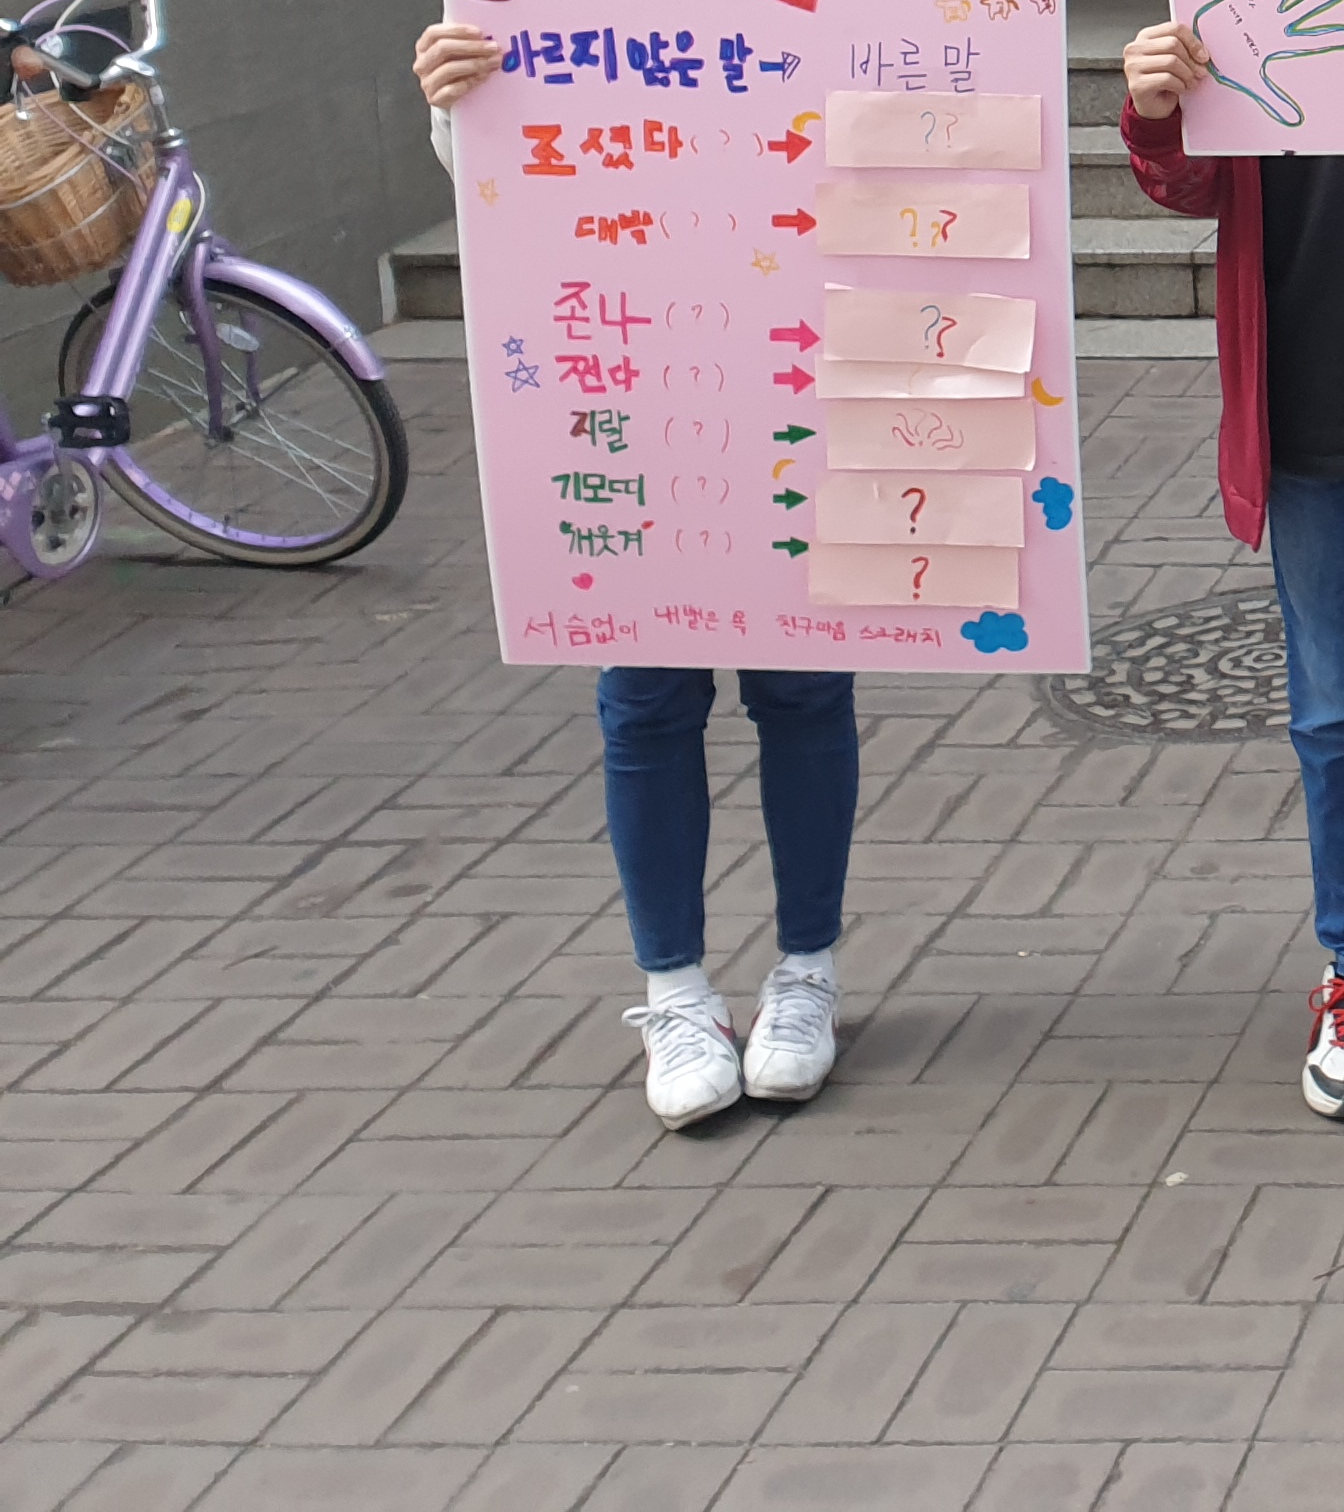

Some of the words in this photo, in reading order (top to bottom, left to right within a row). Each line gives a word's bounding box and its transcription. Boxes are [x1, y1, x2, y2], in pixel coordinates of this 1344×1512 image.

[851, 37, 928, 92] 바른
[943, 36, 981, 94] 말
[553, 281, 653, 346] 존나
[569, 408, 631, 455] 지랄
[550, 471, 646, 507] 기모띠
